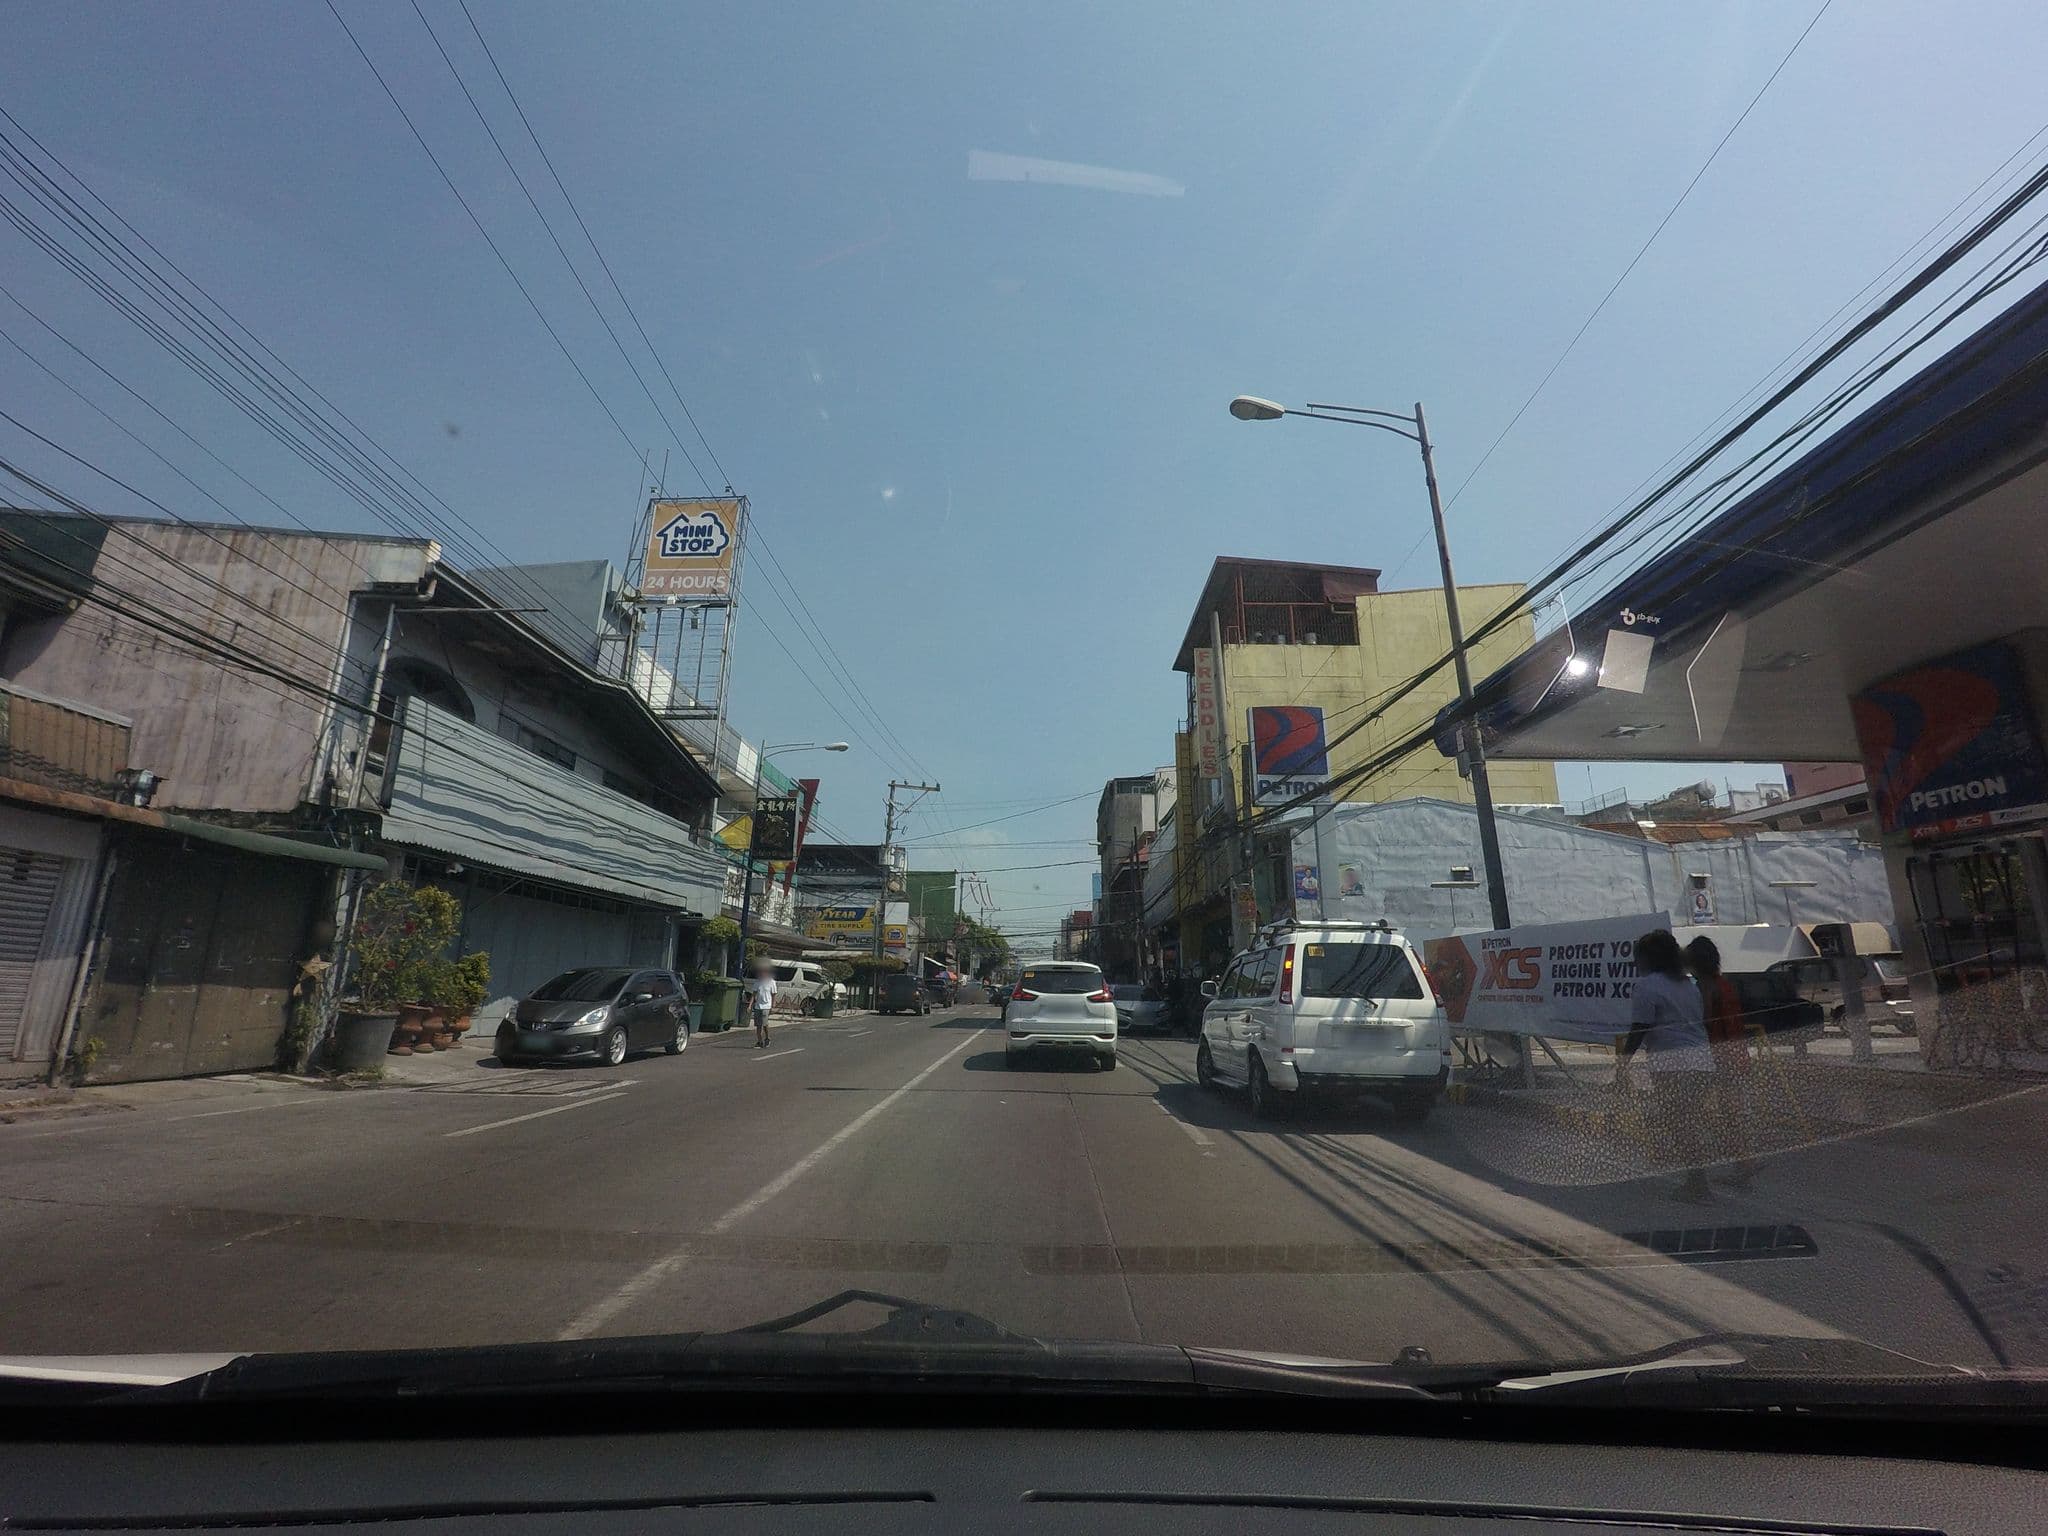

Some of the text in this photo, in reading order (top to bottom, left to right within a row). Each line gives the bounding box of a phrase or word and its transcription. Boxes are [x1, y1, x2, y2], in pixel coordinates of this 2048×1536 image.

[674, 525, 713, 538] MINI
[669, 538, 715, 552] STOP
[647, 576, 725, 589] 24 HOURS
[1197, 651, 1217, 775] FREDDIES
[1910, 775, 2008, 812] PETRON
[1488, 937, 1512, 949] PETRON
[1549, 942, 1605, 960] PROTECT
[1481, 947, 1542, 989] XCS
[1552, 963, 1601, 978] ENGINE
[1553, 982, 1636, 998] PETRON XC
